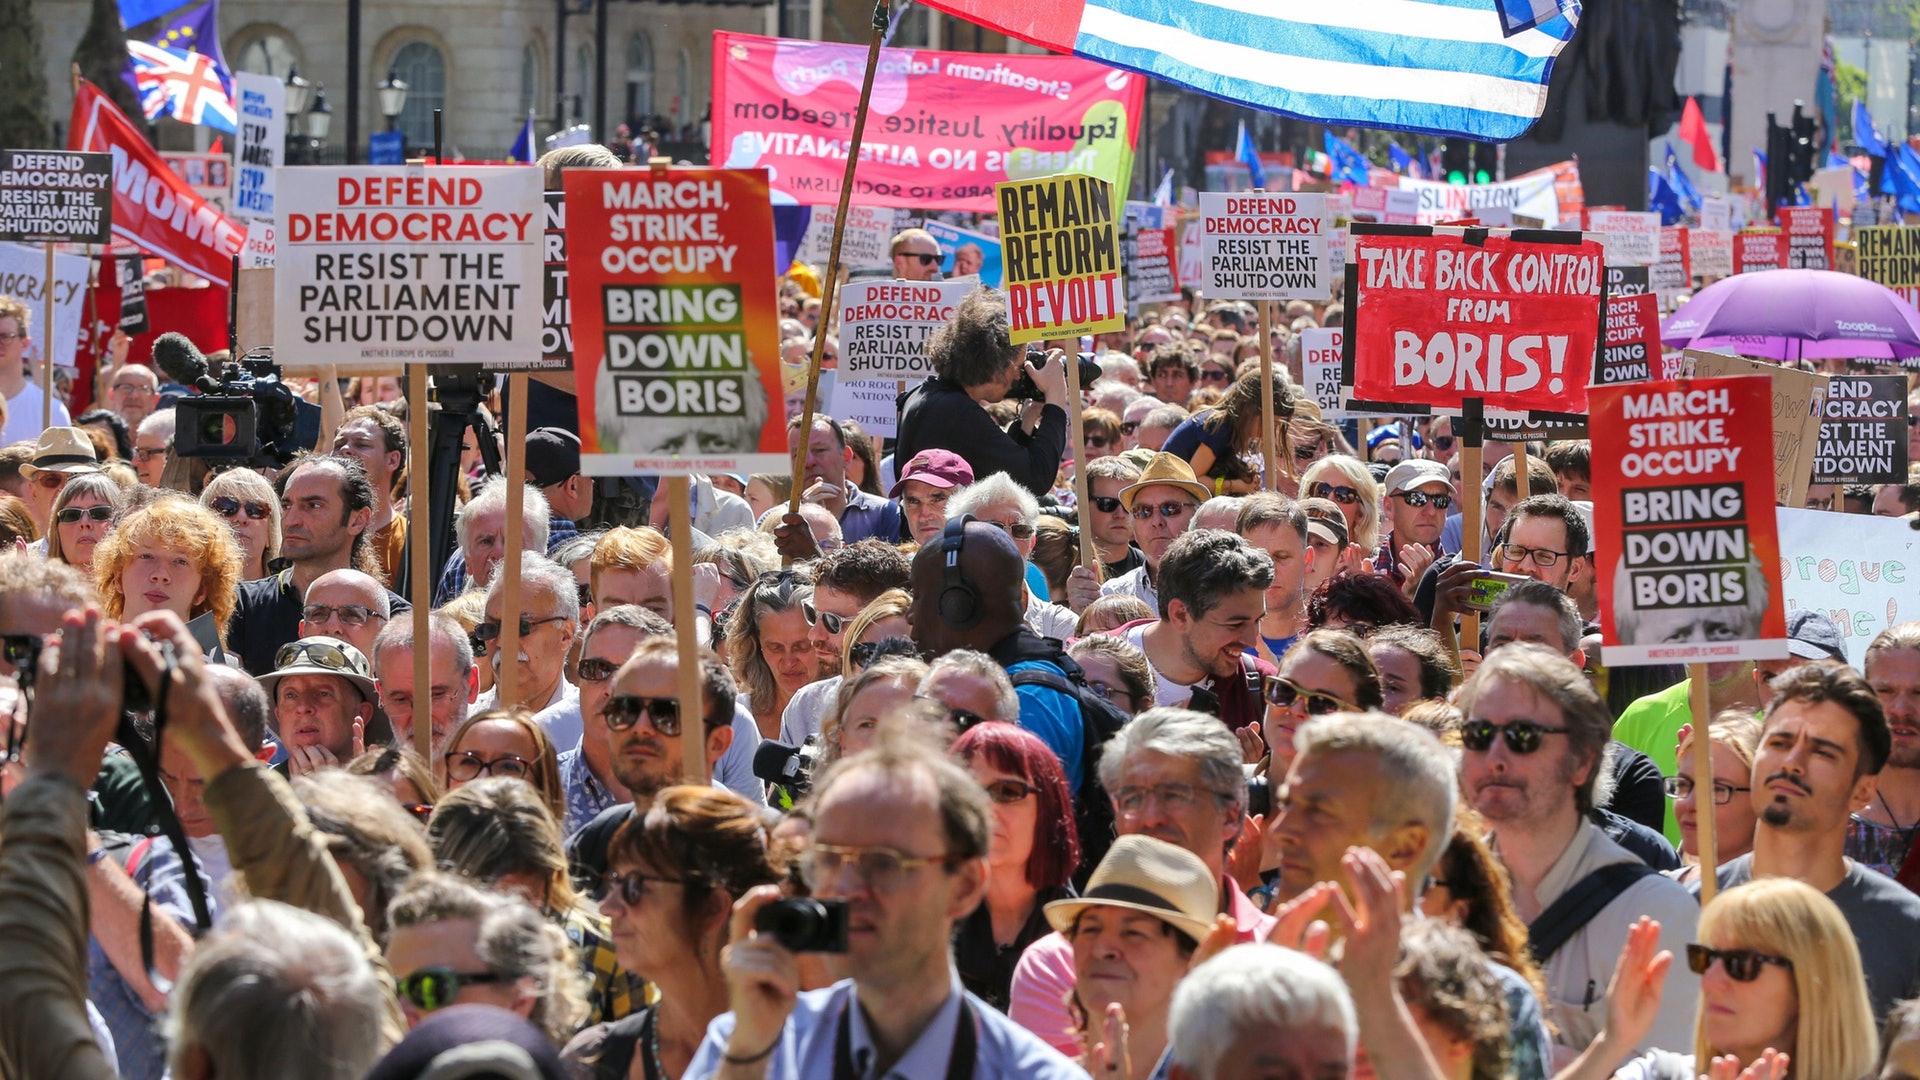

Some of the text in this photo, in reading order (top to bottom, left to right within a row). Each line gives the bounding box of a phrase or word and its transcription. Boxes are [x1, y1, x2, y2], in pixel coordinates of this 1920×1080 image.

[12, 154, 85, 171] DEFEND
[0, 171, 109, 189] EMOCRACY
[1, 189, 95, 206] RESIST THE
[338, 177, 483, 206] DEFEND
[602, 180, 731, 211] MARCH,
[1000, 177, 1111, 235] REMAIN
[1227, 198, 1297, 214] DEFEND
[288, 213, 534, 242] DEMOCRACY
[610, 213, 726, 243] STRIKE,
[1206, 217, 1321, 234] DEMOCRACY
[1005, 223, 1115, 282] REFORM
[1218, 240, 1310, 254] RESIST THE
[315, 253, 504, 280] RESIST THE
[601, 245, 739, 274] OCCUPY
[1212, 257, 1318, 271] PARLIAMENT
[1214, 273, 1316, 288] SHUTDOWN
[1360, 248, 1426, 289] TAKE
[1435, 250, 1501, 293] BACK
[1507, 253, 1603, 296] CONTROL
[300, 284, 521, 312] PARLIAMENT
[867, 286, 942, 302] DEFEND
[1010, 272, 1117, 331] REVOLT
[606, 288, 738, 323] BRING
[845, 304, 953, 322] DEMOCRAC
[1447, 298, 1511, 323] FROM
[1607, 301, 1641, 315] RCH,
[303, 315, 513, 343] SHUTDOWN
[856, 325, 913, 339] RESIST
[1606, 314, 1639, 329] RIKE,
[1606, 327, 1645, 342] CUPY
[608, 334, 743, 368] DOWN
[848, 341, 923, 356] PARLIAM
[1605, 345, 1645, 363] RING
[1394, 330, 1570, 395] BORIS!
[1604, 362, 1647, 382] OWN
[618, 379, 742, 414] BORIS
[852, 391, 896, 401] NATION?
[1828, 381, 1873, 398] END
[1623, 389, 1736, 419] MARCH,
[1826, 400, 1902, 418] CRACY
[1629, 418, 1730, 448] STRIKE,
[1847, 423, 1886, 439] THE
[1817, 440, 1896, 456] IAMENT
[1621, 447, 1742, 477] OCCUPY
[1814, 457, 1892, 474] TDOWN
[1625, 487, 1742, 523] BRING
[1626, 529, 1746, 565] DOWN
[1635, 571, 1744, 606] BORIS
